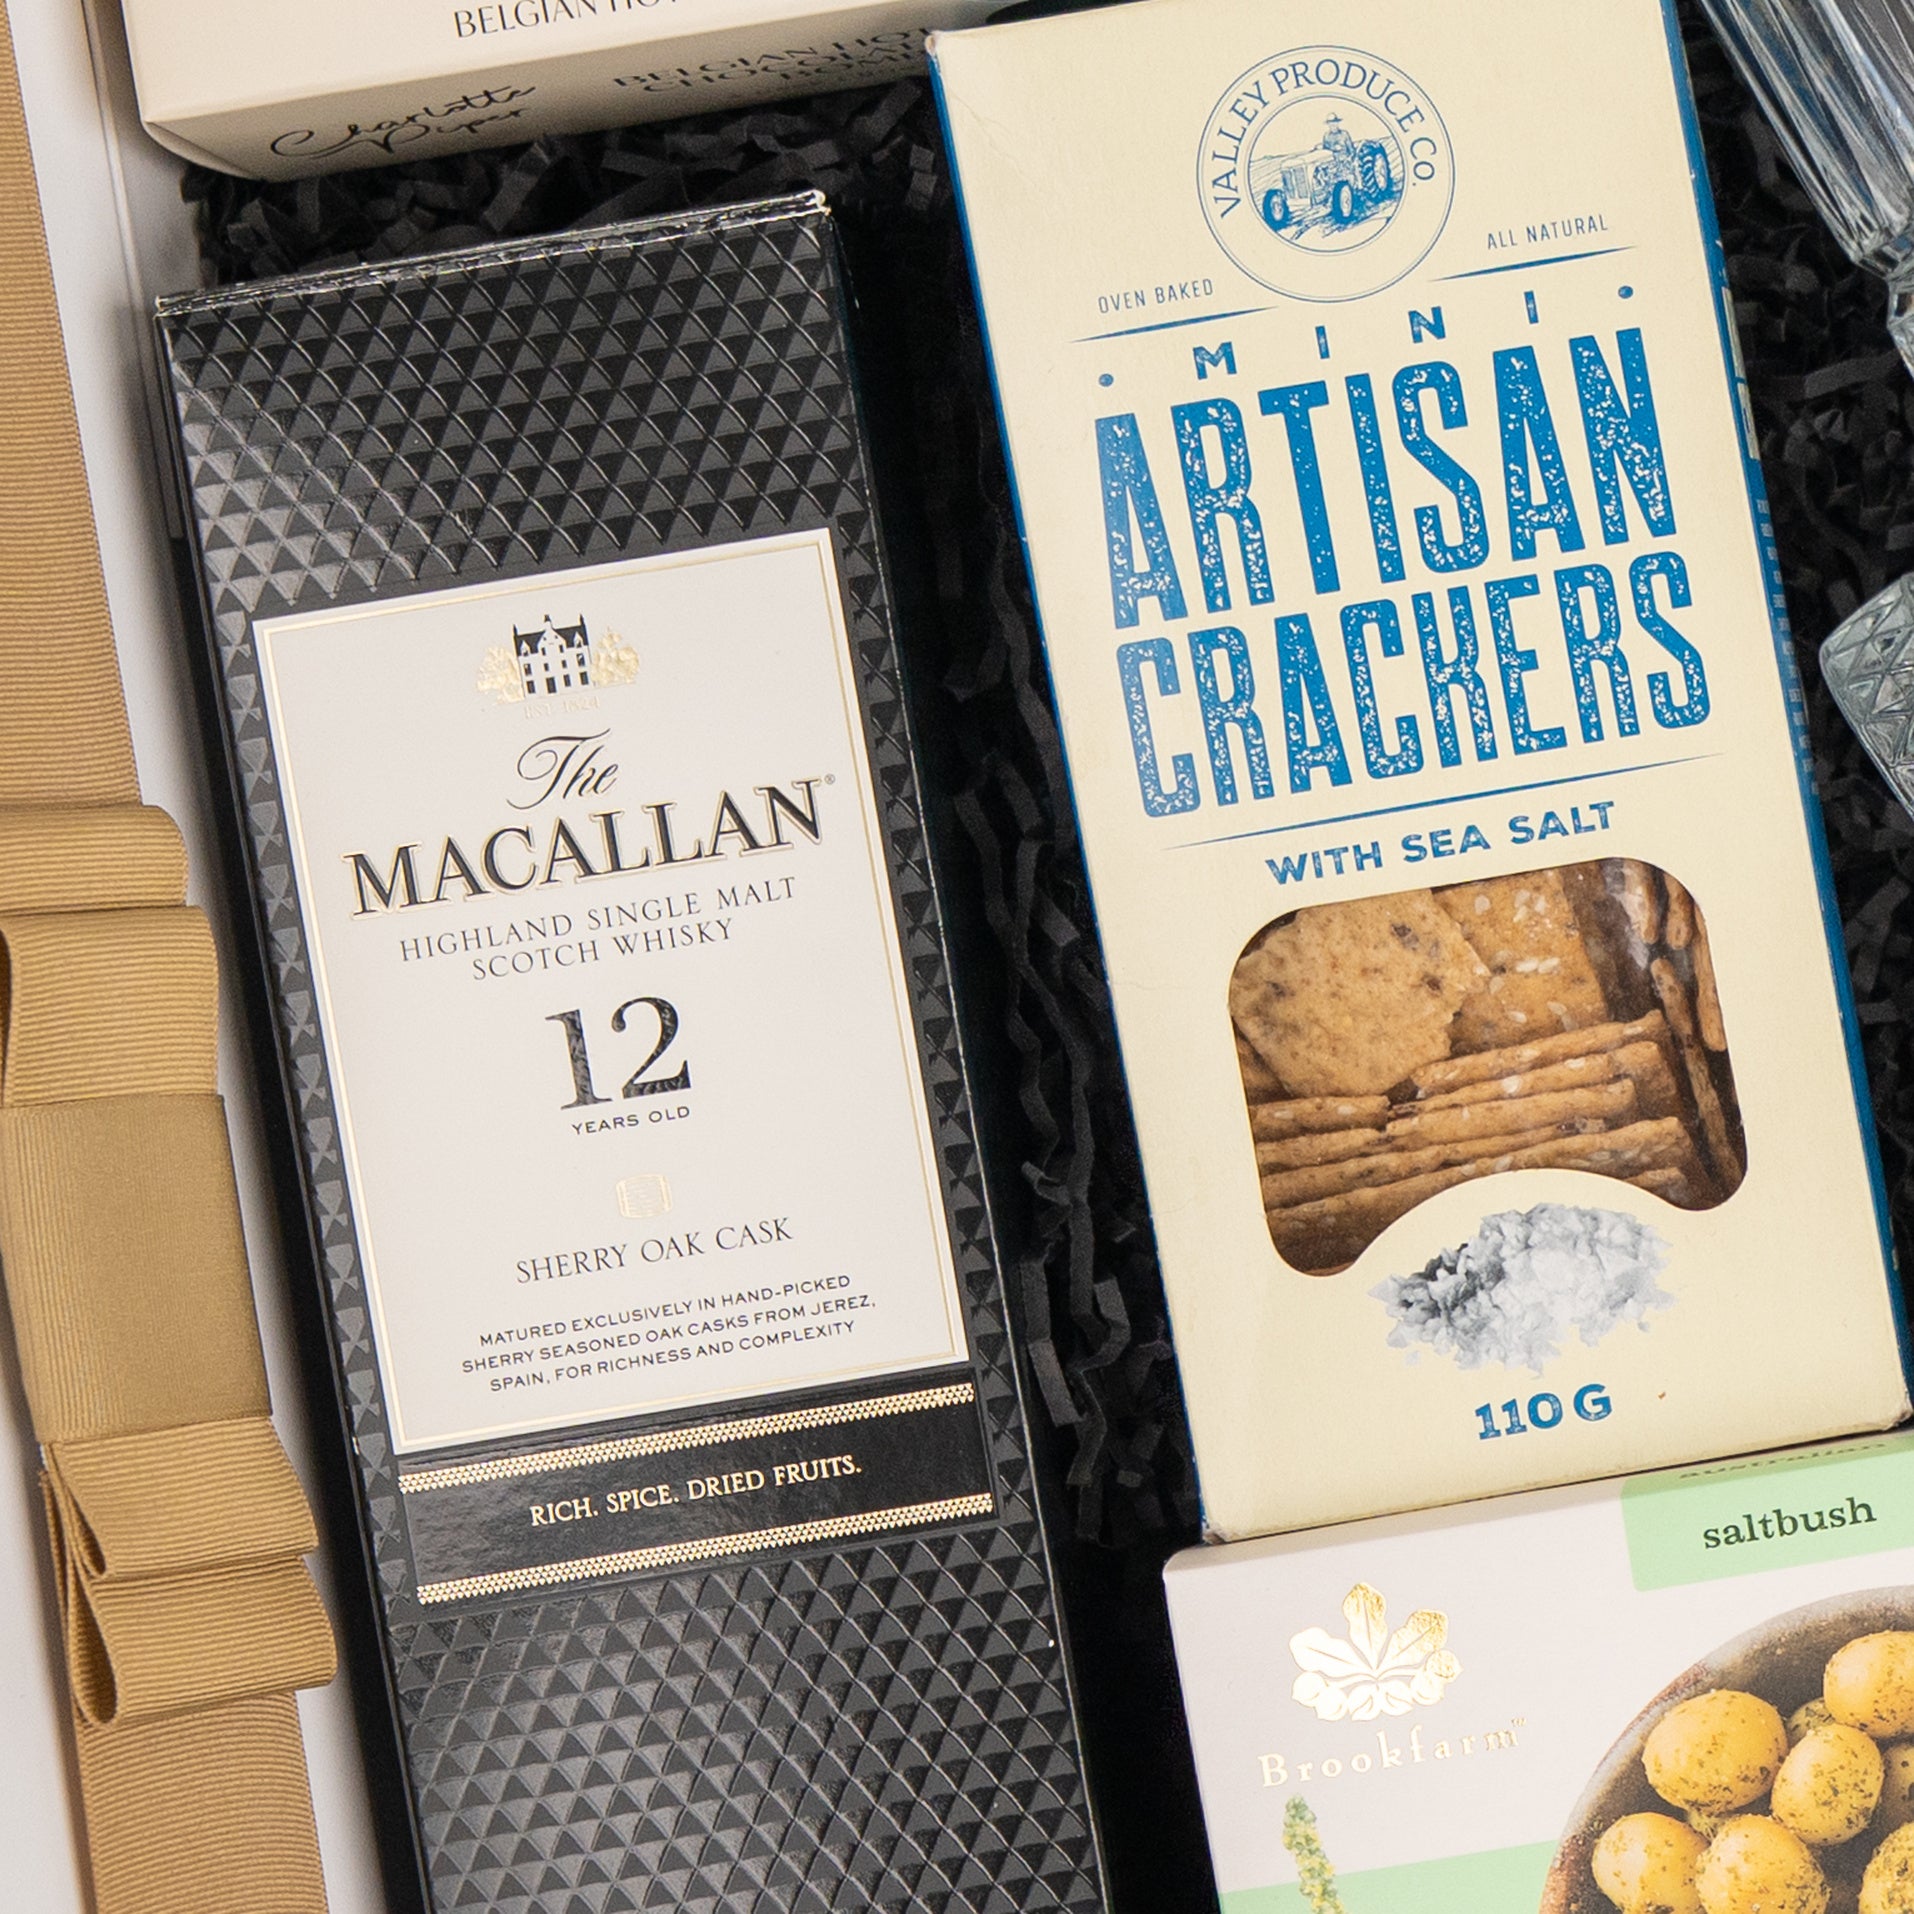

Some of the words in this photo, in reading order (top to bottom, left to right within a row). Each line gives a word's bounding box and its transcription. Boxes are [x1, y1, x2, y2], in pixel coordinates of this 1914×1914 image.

[454, 0, 597, 38] BELGIAN
[613, 46, 818, 86] BELGIAN
[1211, 80, 1270, 219] VALLEY
[1269, 58, 1425, 133] PRODUCE
[1486, 229, 1519, 251] ALL
[1525, 213, 1609, 245] NATURAL
[1098, 294, 1147, 316] OVEN
[1155, 278, 1214, 306] BAKED
[1094, 327, 1678, 630] ARTISAN
[1115, 551, 1711, 819] CRACKERS
[507, 728, 619, 810] The
[1264, 841, 1385, 886] WITH
[1401, 824, 1493, 864] SEA
[1509, 799, 1616, 845] SALT
[400, 913, 573, 962] HIGHLAND
[588, 892, 700, 932] SINGLE
[716, 876, 796, 911] MALT
[472, 939, 600, 981] SCOTCH
[613, 918, 734, 957] WHISKY
[545, 996, 692, 1110] 12
[572, 1114, 640, 1135] YEARS
[648, 1105, 691, 1124] OLD
[516, 1243, 629, 1284] SHERRY
[640, 1233, 705, 1262] OAK
[715, 1217, 793, 1250] CASK
[462, 1350, 535, 1374] SHERRY
[540, 1333, 641, 1360] SEASONED
[646, 1325, 684, 1344] OAK
[688, 1314, 749, 1338] CASKS
[754, 1304, 806, 1326] FROM
[810, 1293, 877, 1318] JEREZ,
[480, 1320, 567, 1347] MATURED
[571, 1300, 693, 1332] EXCLUSIVELY
[698, 1297, 716, 1312] IN
[721, 1275, 851, 1308] HAND-PICKED
[489, 1370, 550, 1393] SPAIN,
[555, 1362, 593, 1381] FOR
[597, 1347, 692, 1374] RICHNESS
[696, 1337, 735, 1357] AND
[738, 1320, 855, 1351] COMPLEXITY
[1474, 1392, 1564, 1441] 110
[1572, 1383, 1614, 1422] G
[529, 1497, 599, 1526] RICH.
[606, 1484, 680, 1513] SPICE.
[688, 1469, 766, 1501] DRIED
[772, 1454, 863, 1487] FRUITS.
[1703, 1496, 1877, 1549] saltbush
